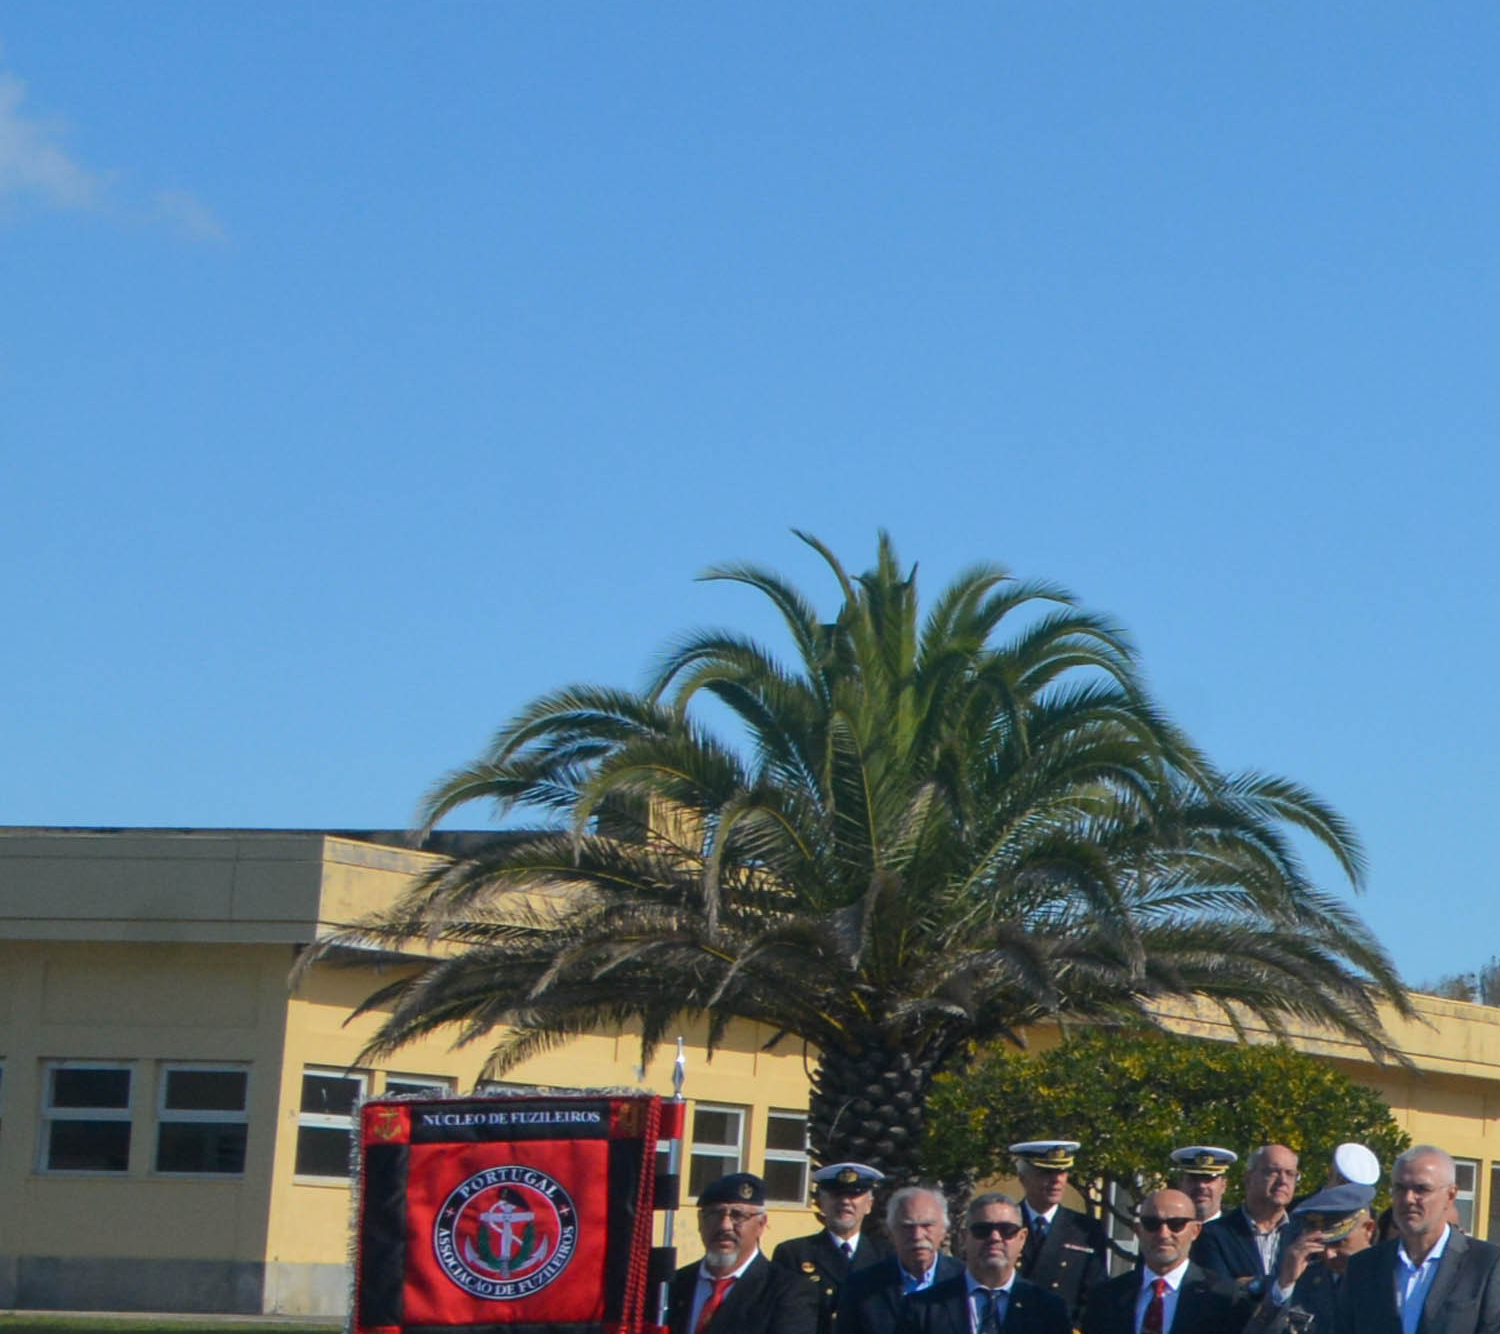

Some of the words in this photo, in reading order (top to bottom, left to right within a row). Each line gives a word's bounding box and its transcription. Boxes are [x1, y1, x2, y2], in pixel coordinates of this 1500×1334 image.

[423, 1111, 486, 1126] NÚCLEO
[487, 1113, 509, 1125] DE
[510, 1110, 601, 1124] FUZILEIROS
[459, 1169, 558, 1198] PORTUGAL
[495, 1284, 516, 1295] DE
[518, 1226, 574, 1293] FUZILEIROS
